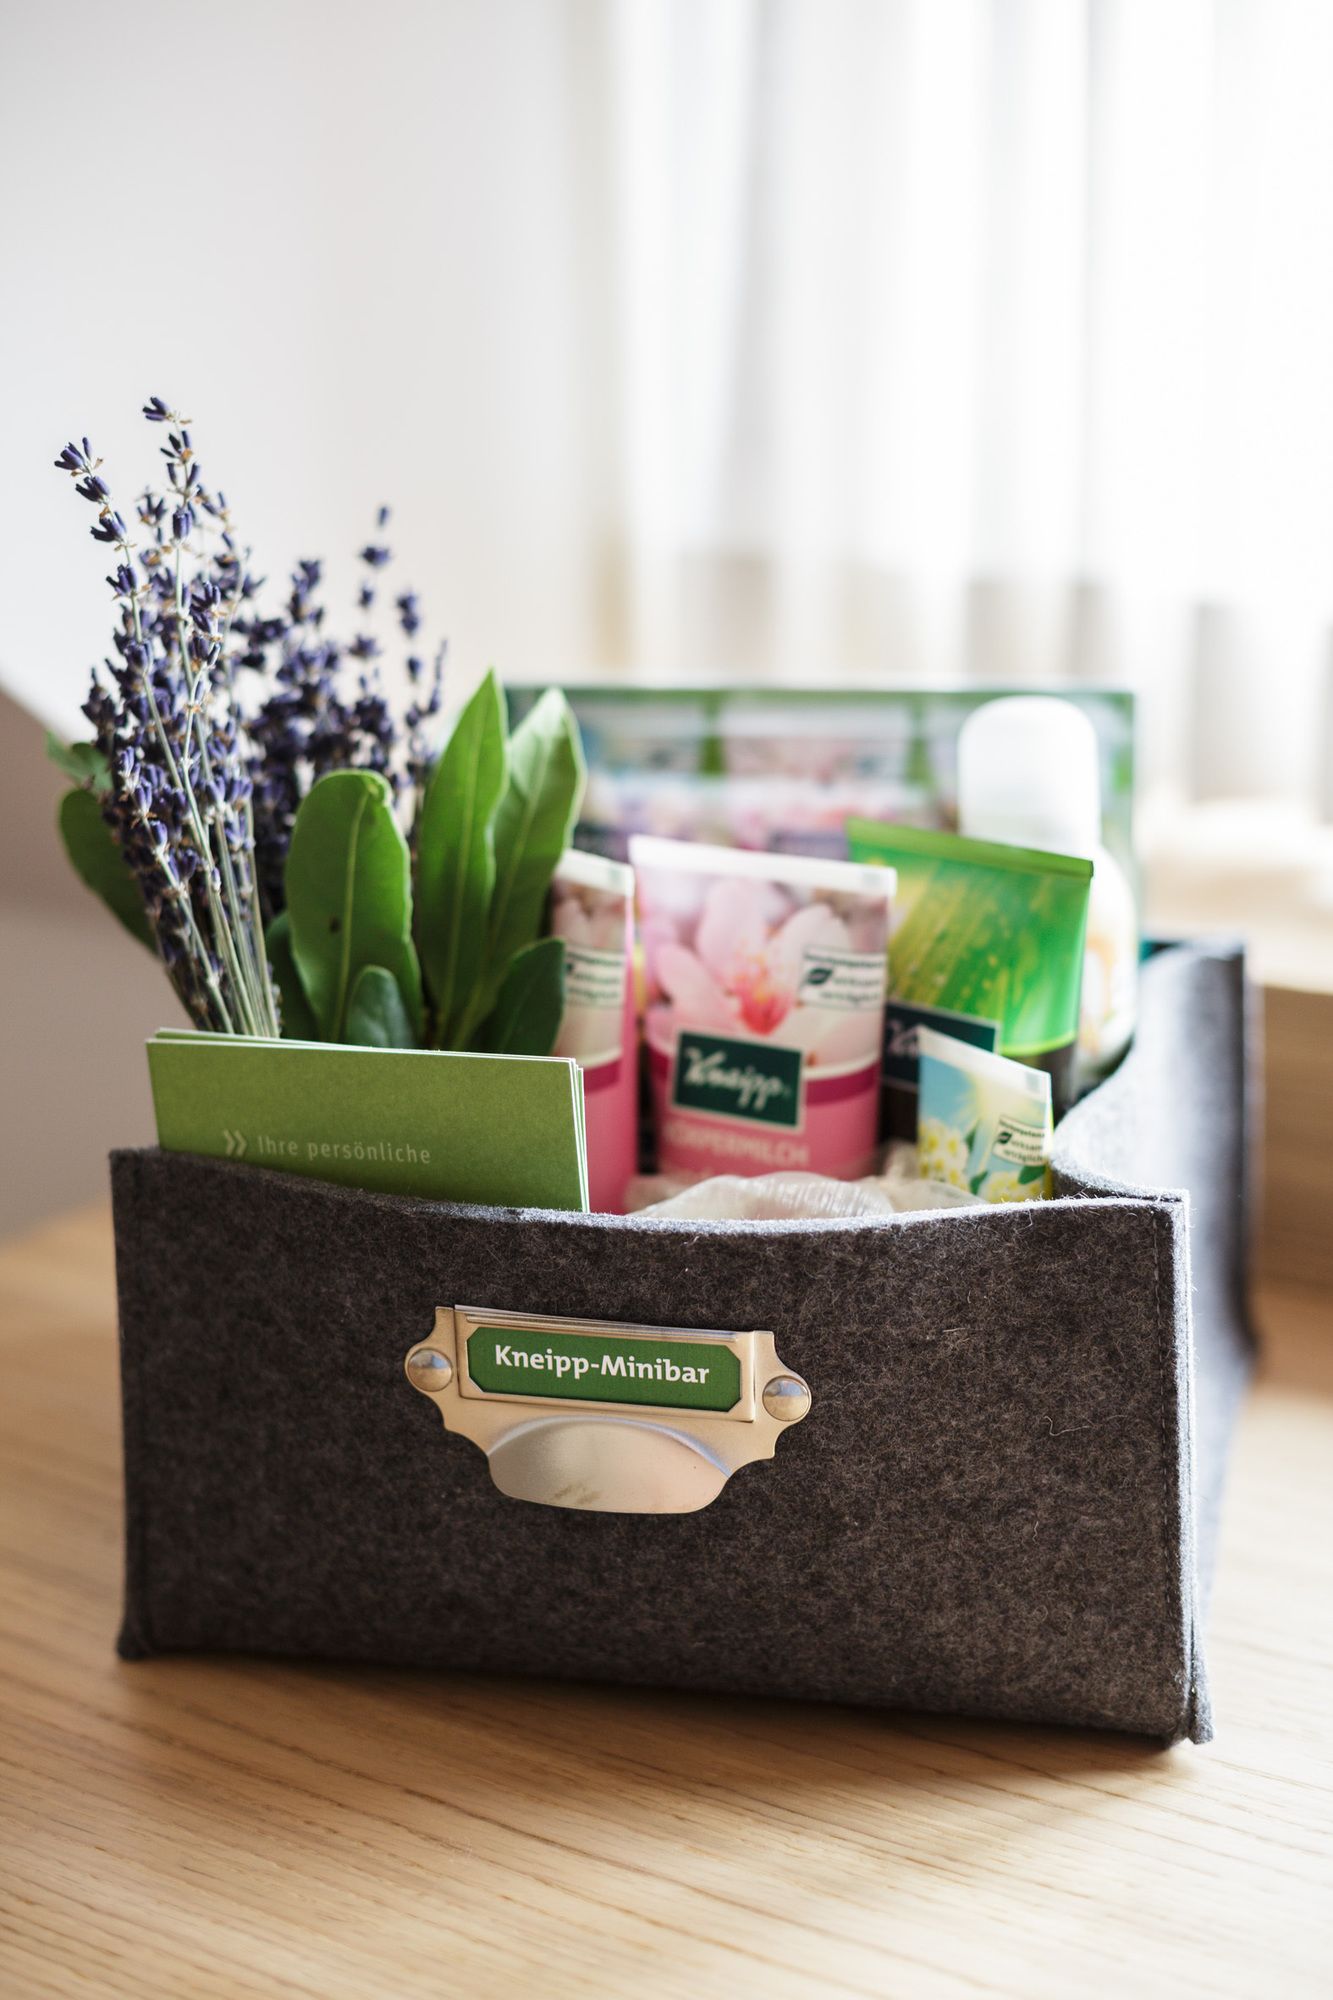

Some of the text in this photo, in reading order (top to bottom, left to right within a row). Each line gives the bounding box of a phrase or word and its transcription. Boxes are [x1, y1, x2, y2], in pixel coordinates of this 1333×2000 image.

[257, 1135, 432, 1166] Ihre persönliche
[494, 1344, 710, 1385] Kneipp-Minibar
